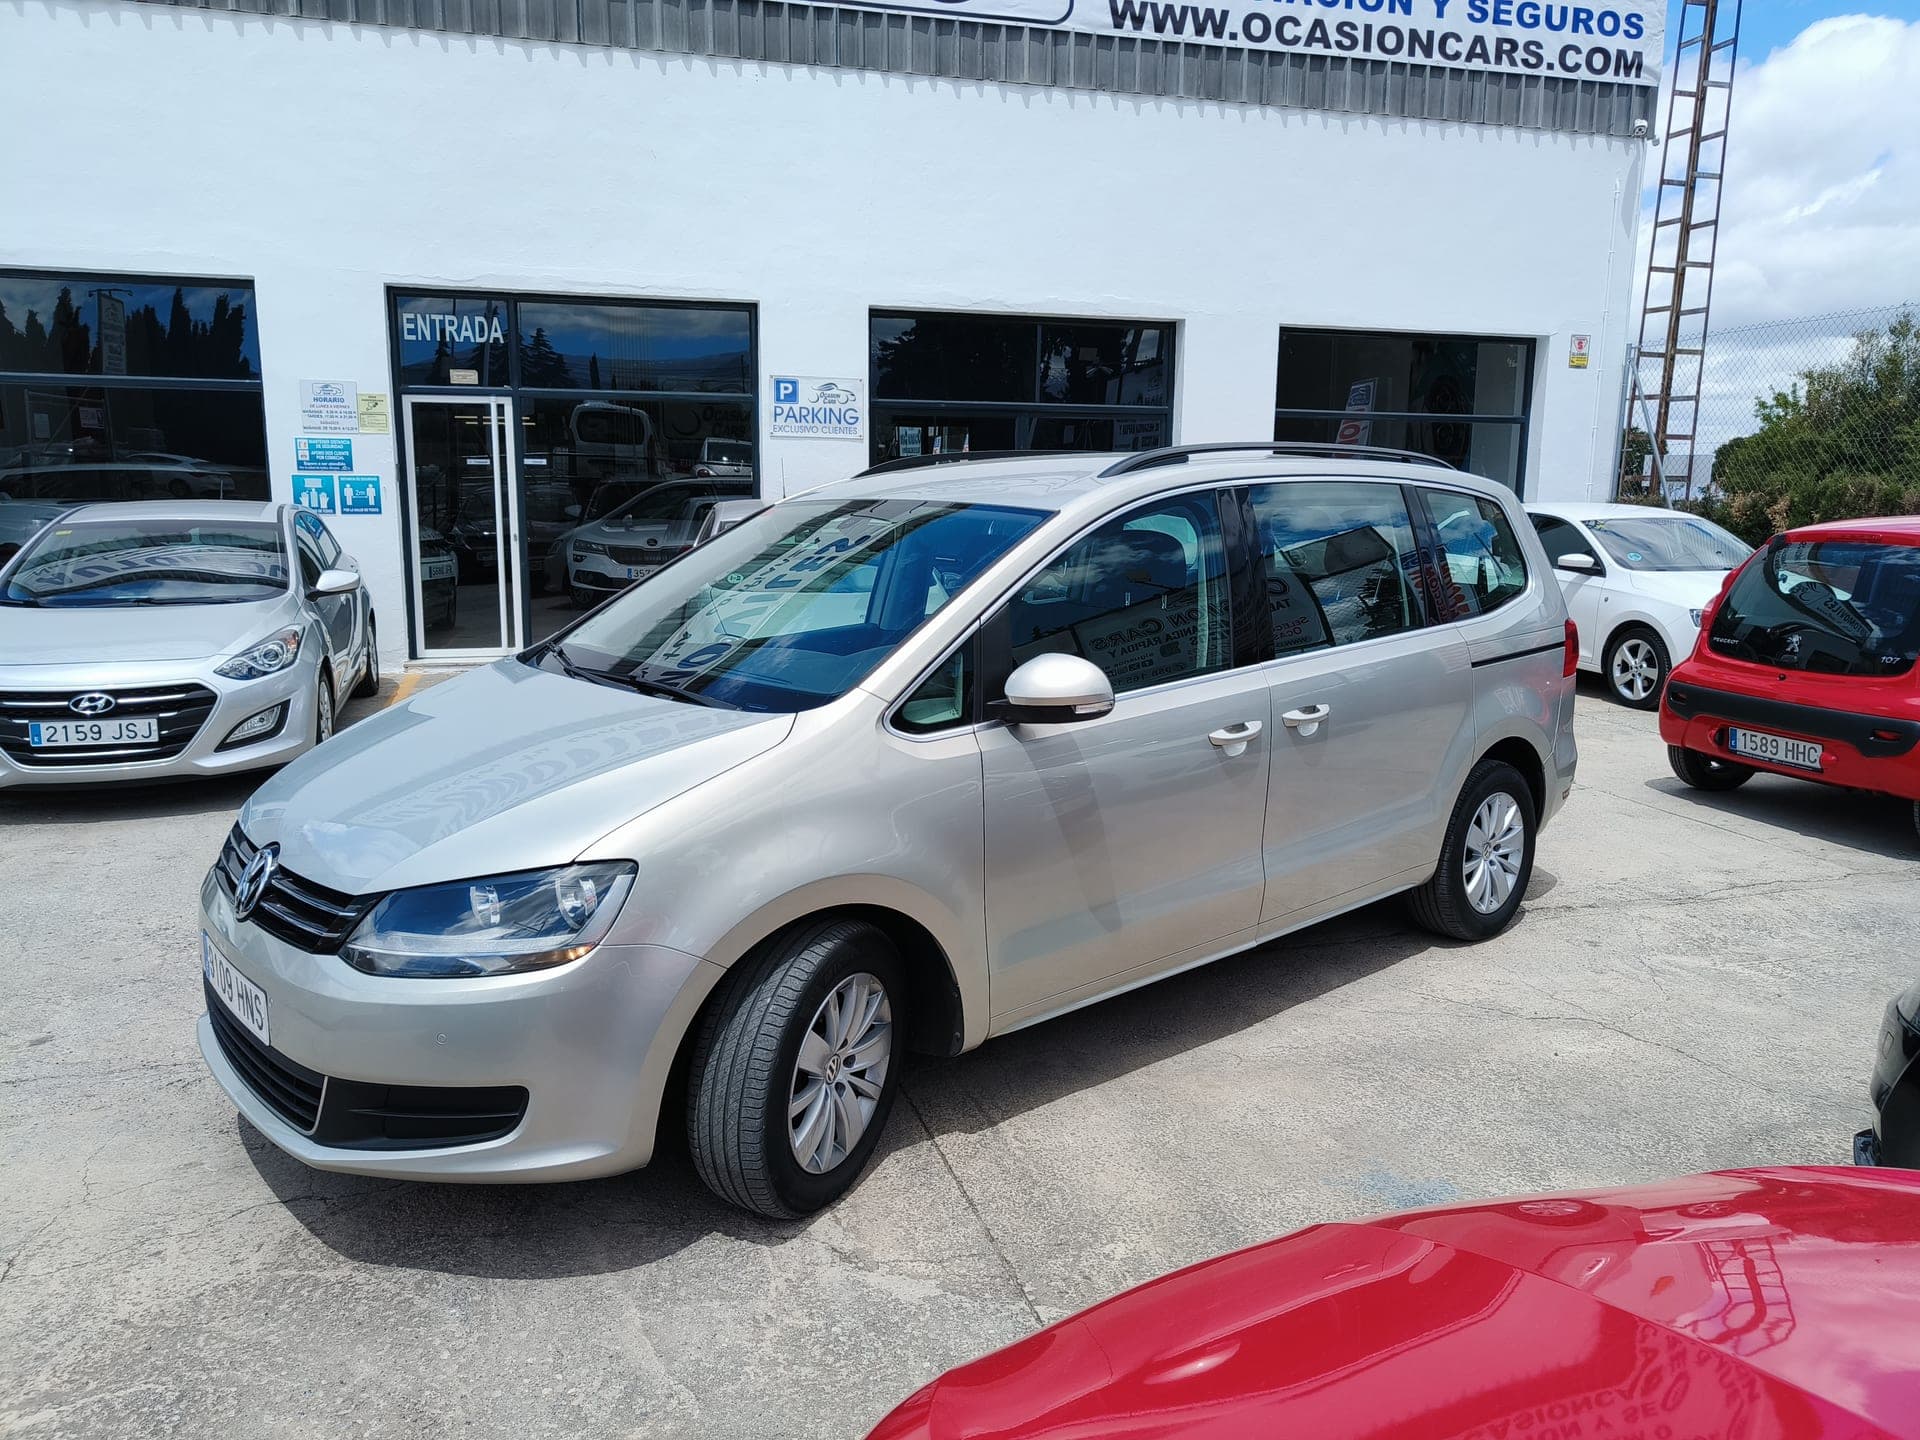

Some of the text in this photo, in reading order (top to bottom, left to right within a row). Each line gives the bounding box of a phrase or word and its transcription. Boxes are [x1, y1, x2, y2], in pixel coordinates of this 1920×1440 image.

[1466, 0, 1645, 40] SEGUROS
[1109, 0, 1643, 79] WWW.OCASIONCARS.COM
[402, 312, 504, 344] ENTRADA
[780, 382, 793, 401] P
[773, 405, 860, 425] PARKING
[772, 424, 858, 435] EXCLUSIVO CLIENTES
[1880, 655, 1901, 665] 107
[45, 723, 102, 743] 2159
[111, 721, 153, 741] JSJ
[1741, 732, 1779, 756] 1589
[1784, 741, 1818, 764] HHC
[235, 976, 265, 1031] HNS
